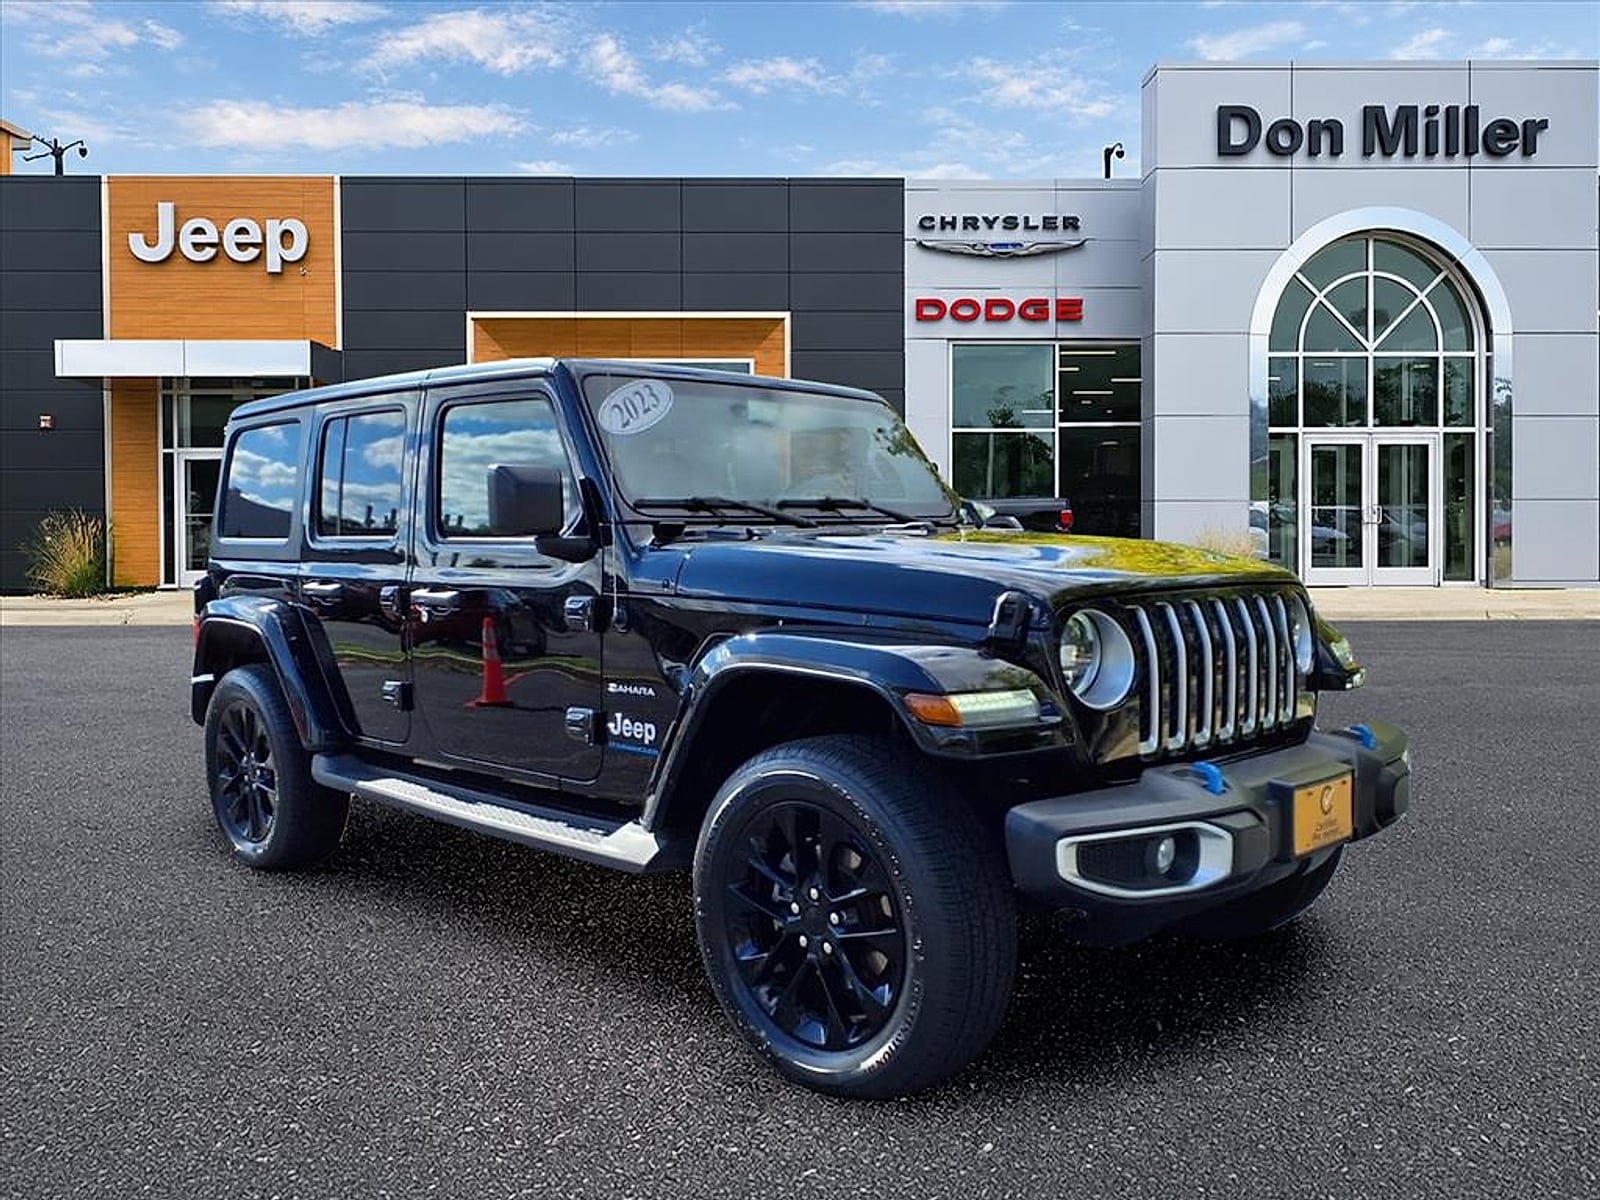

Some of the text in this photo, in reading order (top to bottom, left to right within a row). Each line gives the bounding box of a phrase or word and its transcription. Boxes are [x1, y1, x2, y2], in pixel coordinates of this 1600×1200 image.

[1217, 104, 1548, 157] Don Miller
[128, 201, 309, 273] Jeep
[918, 215, 1081, 231] CHRYSLER
[916, 298, 1083, 321] DODGE
[611, 383, 660, 428] 2023
[607, 682, 656, 697] SAHARA
[607, 712, 656, 745] Jeep
